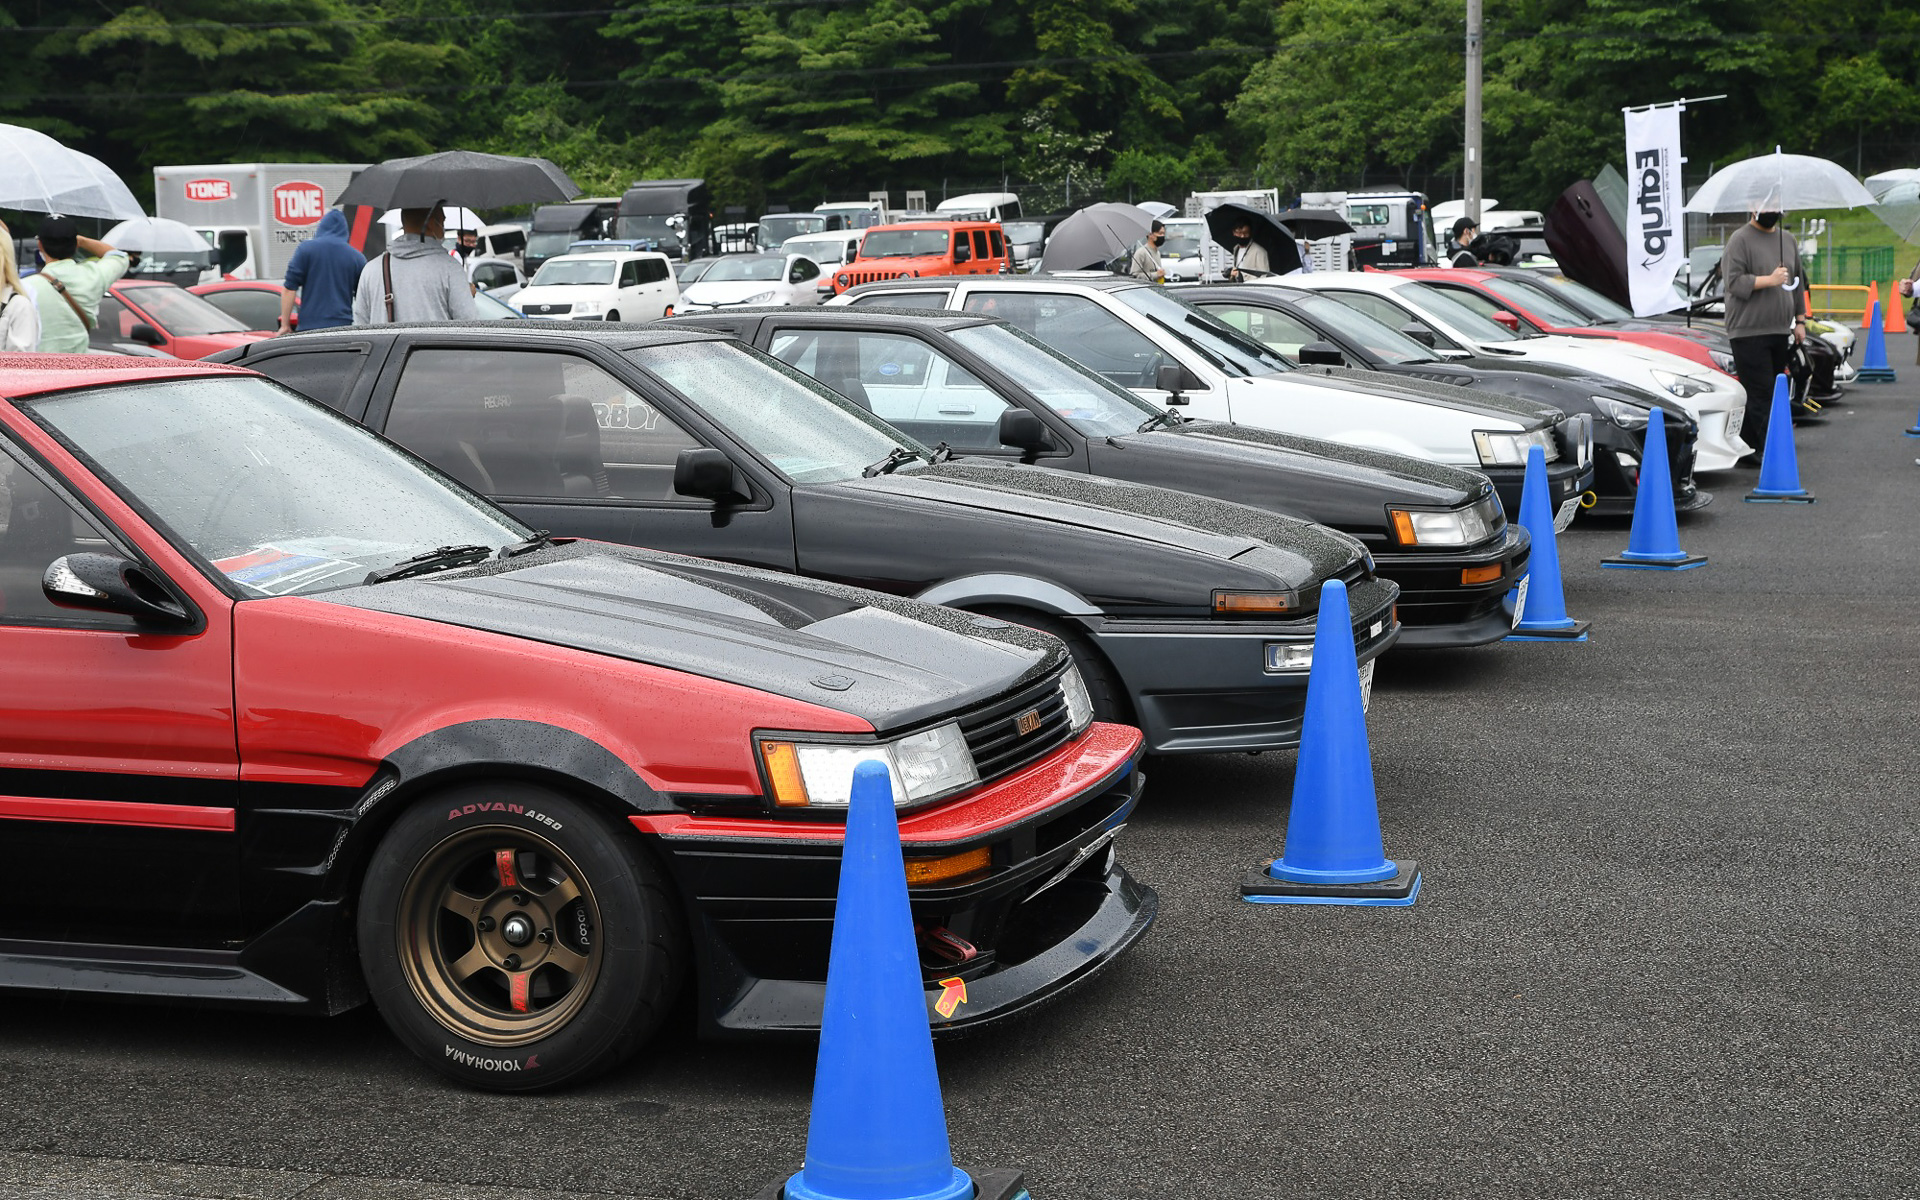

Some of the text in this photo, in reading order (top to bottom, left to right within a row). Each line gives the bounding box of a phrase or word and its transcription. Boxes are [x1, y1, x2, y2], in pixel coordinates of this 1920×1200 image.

[187, 182, 229, 199] TONE
[276, 189, 322, 218] TONE
[275, 230, 297, 243] TONE
[484, 395, 512, 409] RECARO
[447, 802, 525, 820] ADVAN
[445, 1044, 522, 1072] YOKOHAMA
